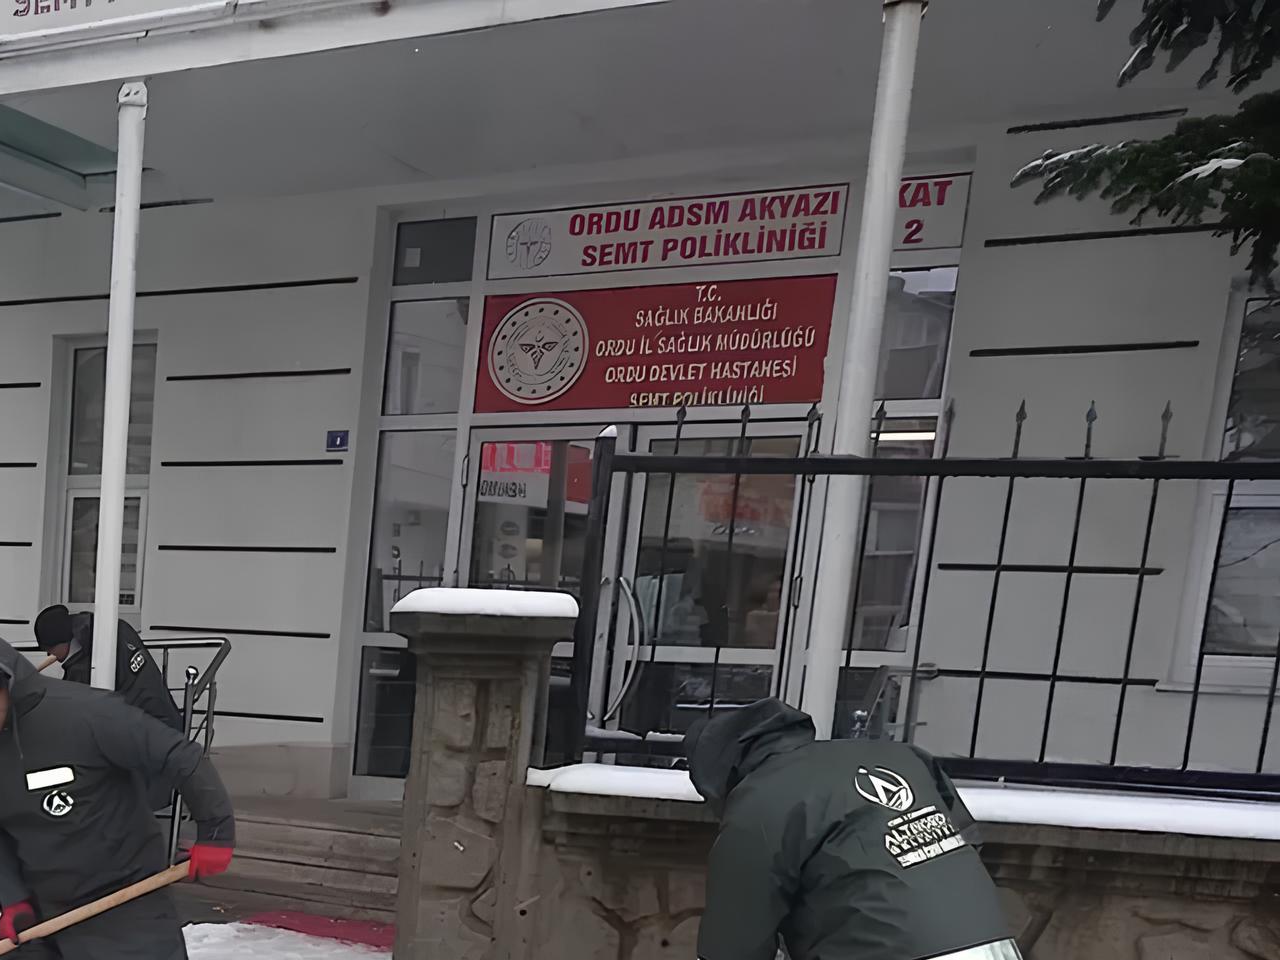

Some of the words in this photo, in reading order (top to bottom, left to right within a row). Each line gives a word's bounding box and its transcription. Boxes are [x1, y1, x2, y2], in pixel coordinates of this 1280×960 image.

[568, 208, 640, 237] ORDU
[648, 199, 730, 231] ADSM
[738, 190, 841, 223] AKYAZI
[581, 239, 655, 267] SEMT
[661, 221, 828, 262] POLİKLİNİĞİ
[902, 218, 924, 244] 2
[695, 284, 722, 303] T.C.
[635, 305, 690, 328] SAĞLIK
[595, 339, 636, 357] ORDU
[656, 331, 711, 354] SAĞLIK
[605, 365, 647, 383] ORDU
[649, 362, 708, 382] DEVLET
